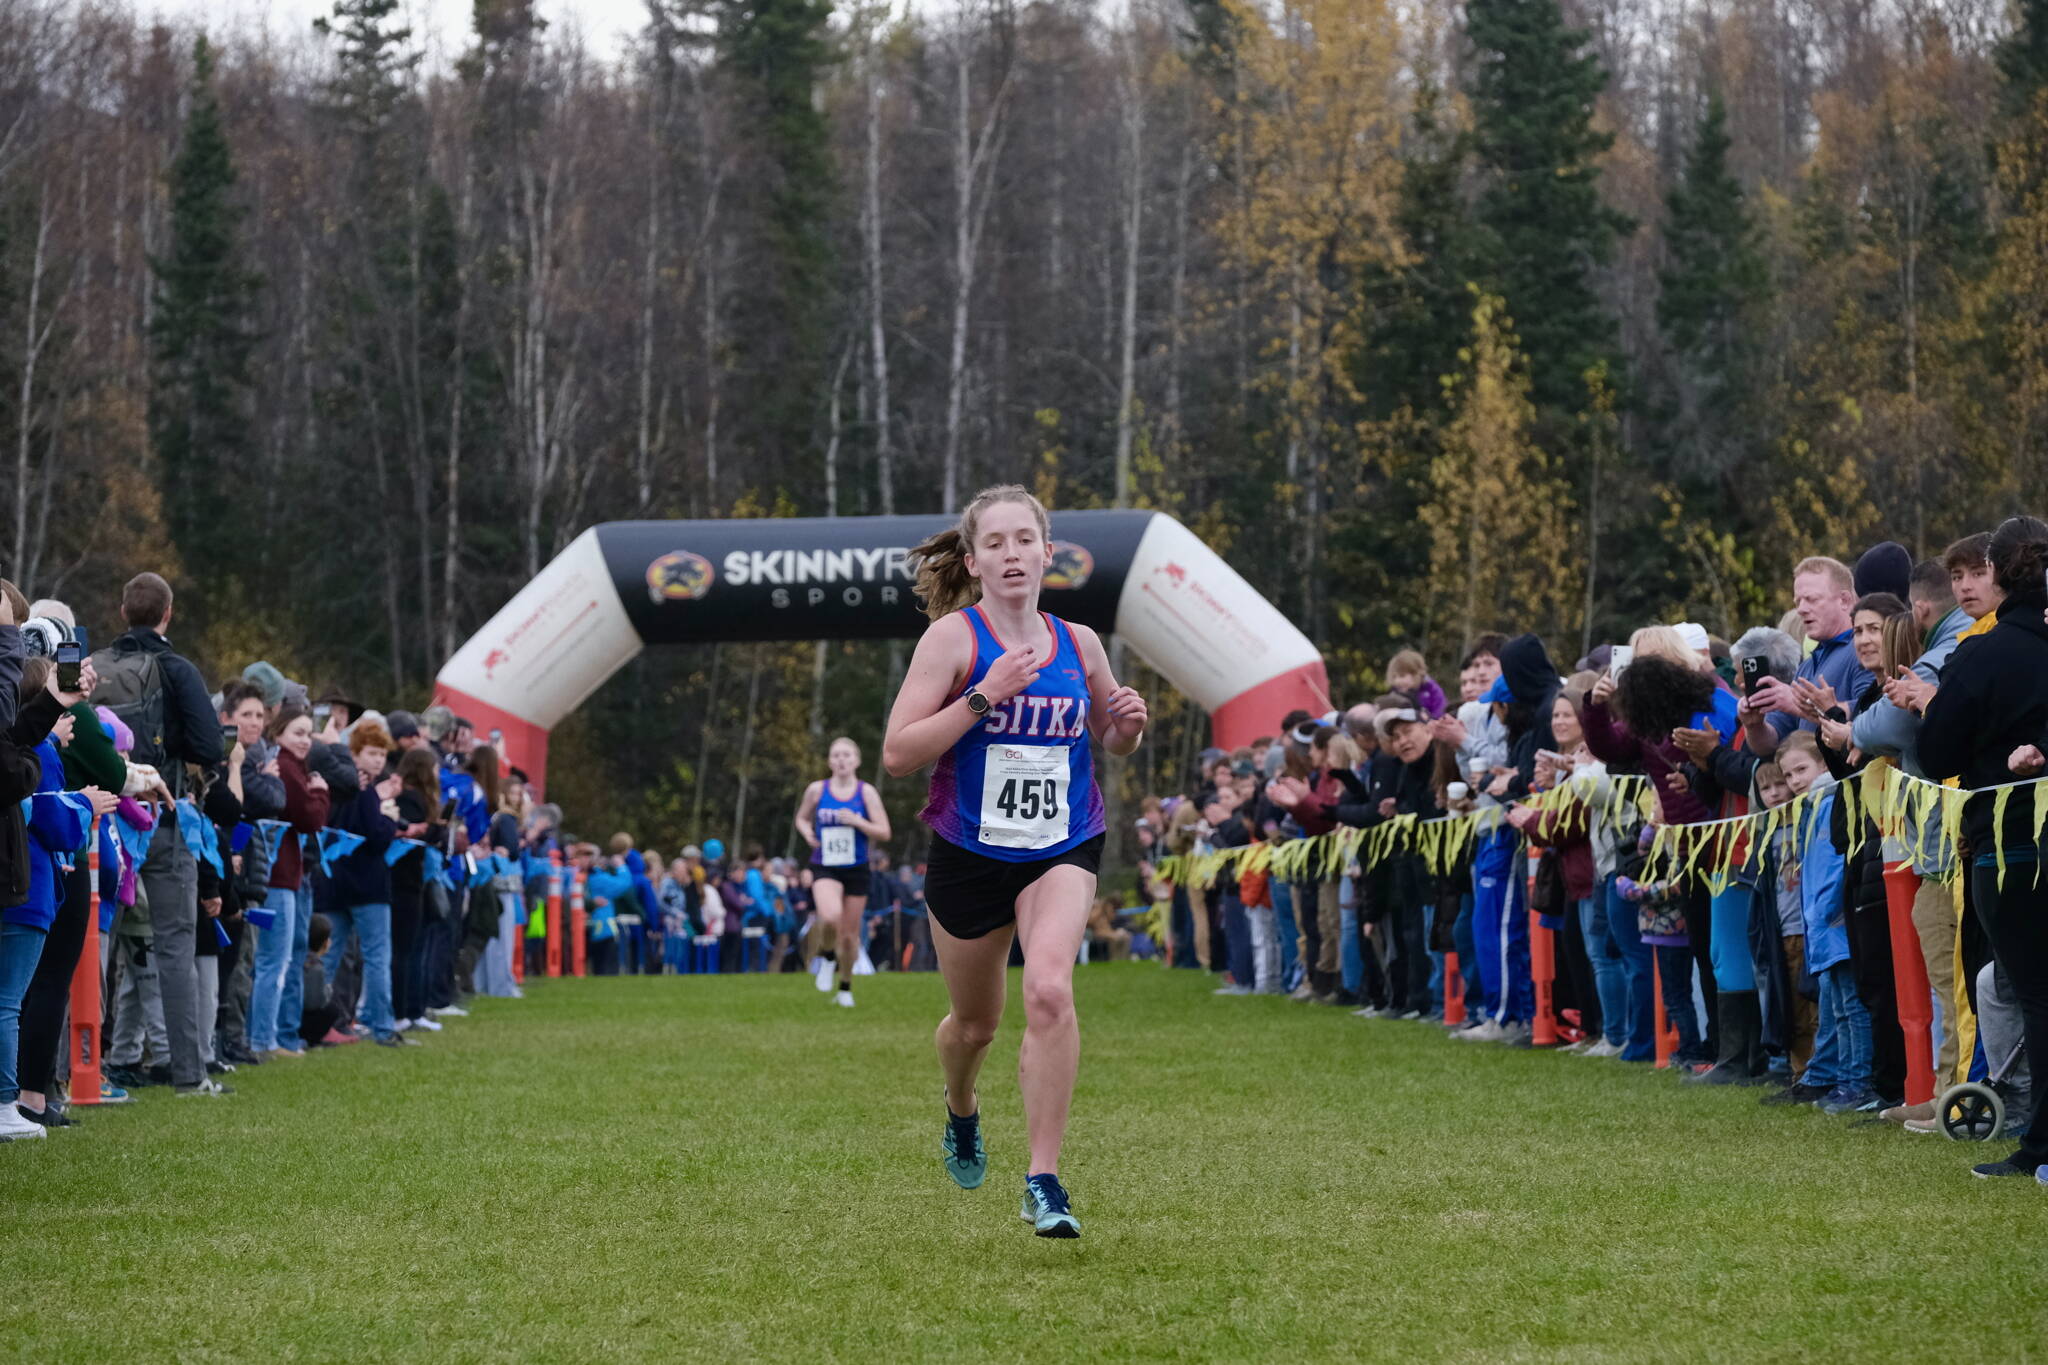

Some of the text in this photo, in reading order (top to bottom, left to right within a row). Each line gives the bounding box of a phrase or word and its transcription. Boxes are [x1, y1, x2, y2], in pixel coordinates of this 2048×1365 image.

[724, 548, 936, 585] SKINNYR
[771, 586, 928, 608] SPOR
[984, 695, 1087, 738] SITKA
[1005, 750, 1023, 760] GCI
[997, 778, 1059, 820] 459
[827, 838, 849, 854] 452
